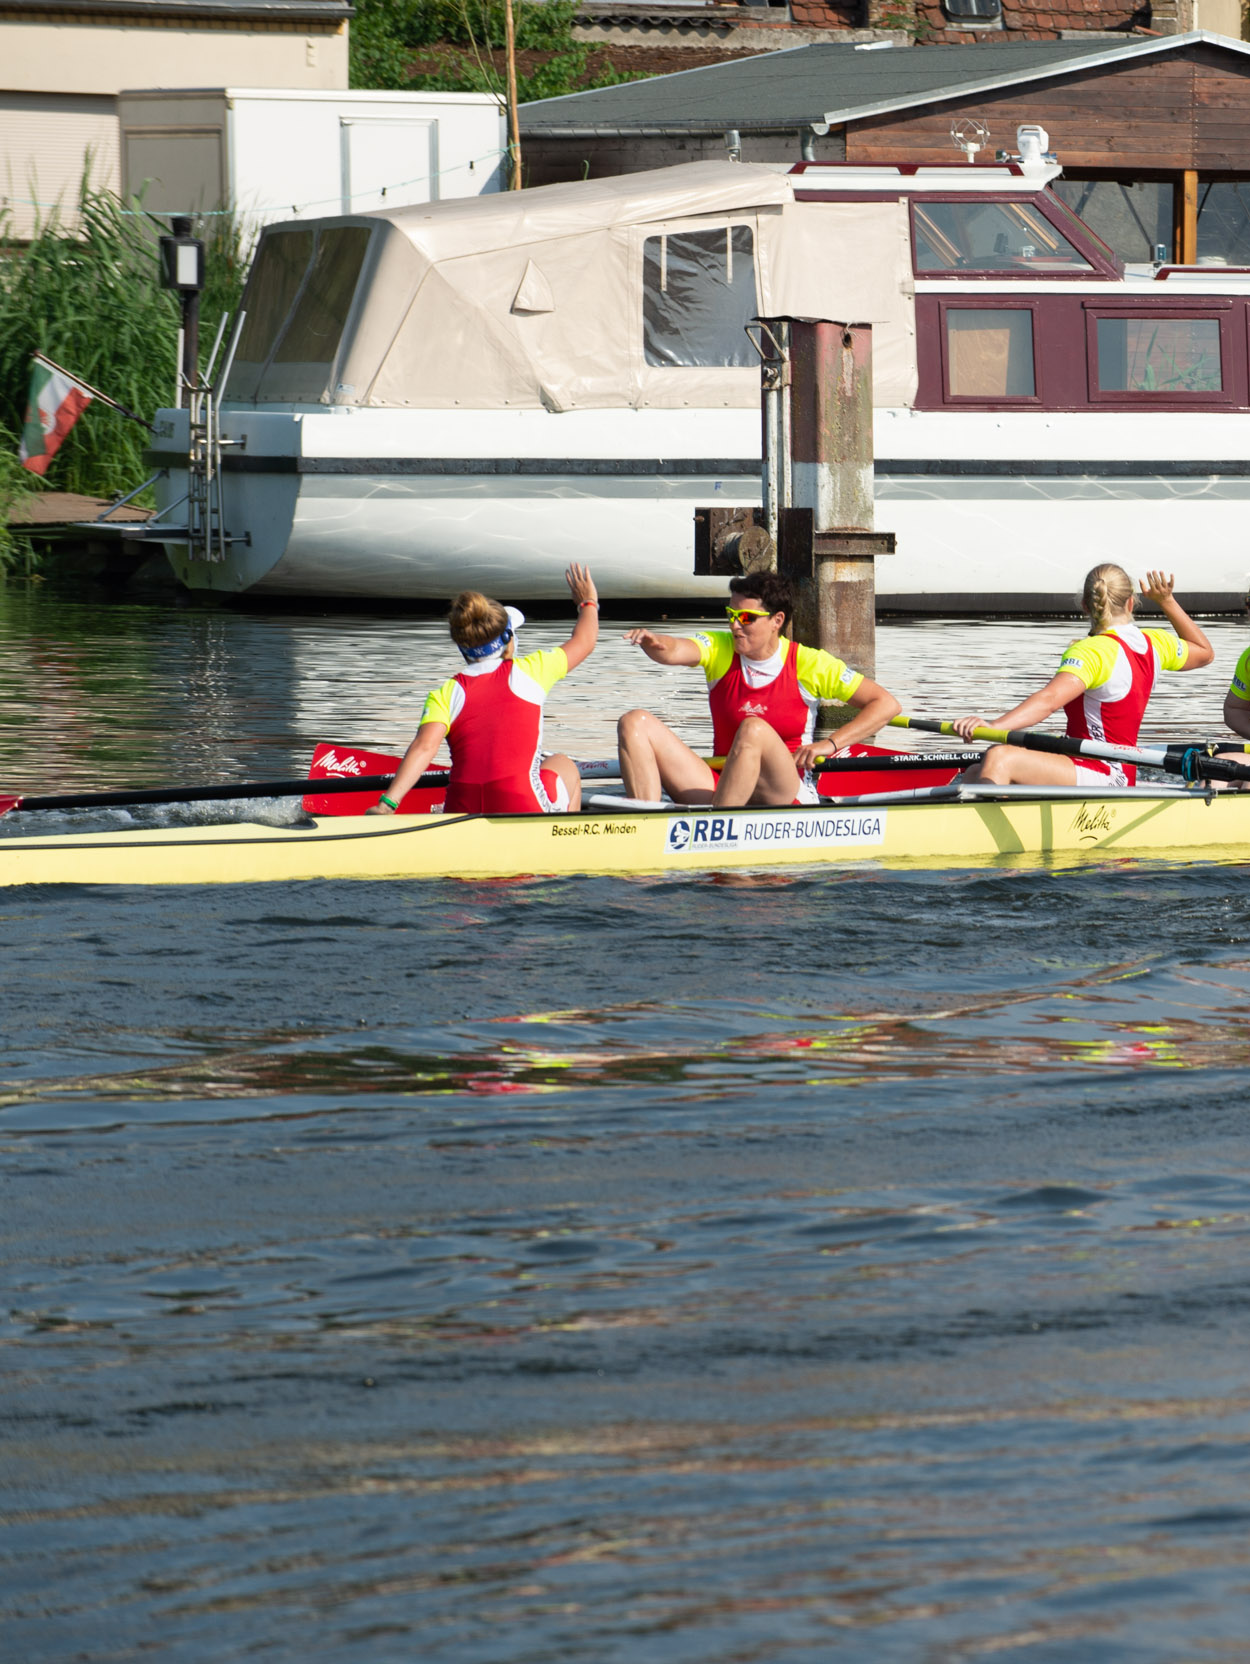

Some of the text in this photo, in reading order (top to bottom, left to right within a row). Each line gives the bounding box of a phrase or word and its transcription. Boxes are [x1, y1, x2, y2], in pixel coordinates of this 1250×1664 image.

[314, 750, 362, 776] Melitta
[894, 751, 981, 762] STARK. SCHNELL. GUT.
[551, 822, 637, 837] Bessel-R.C. Minden
[693, 818, 881, 842] RBL RUDER-BUNDESLIGA
